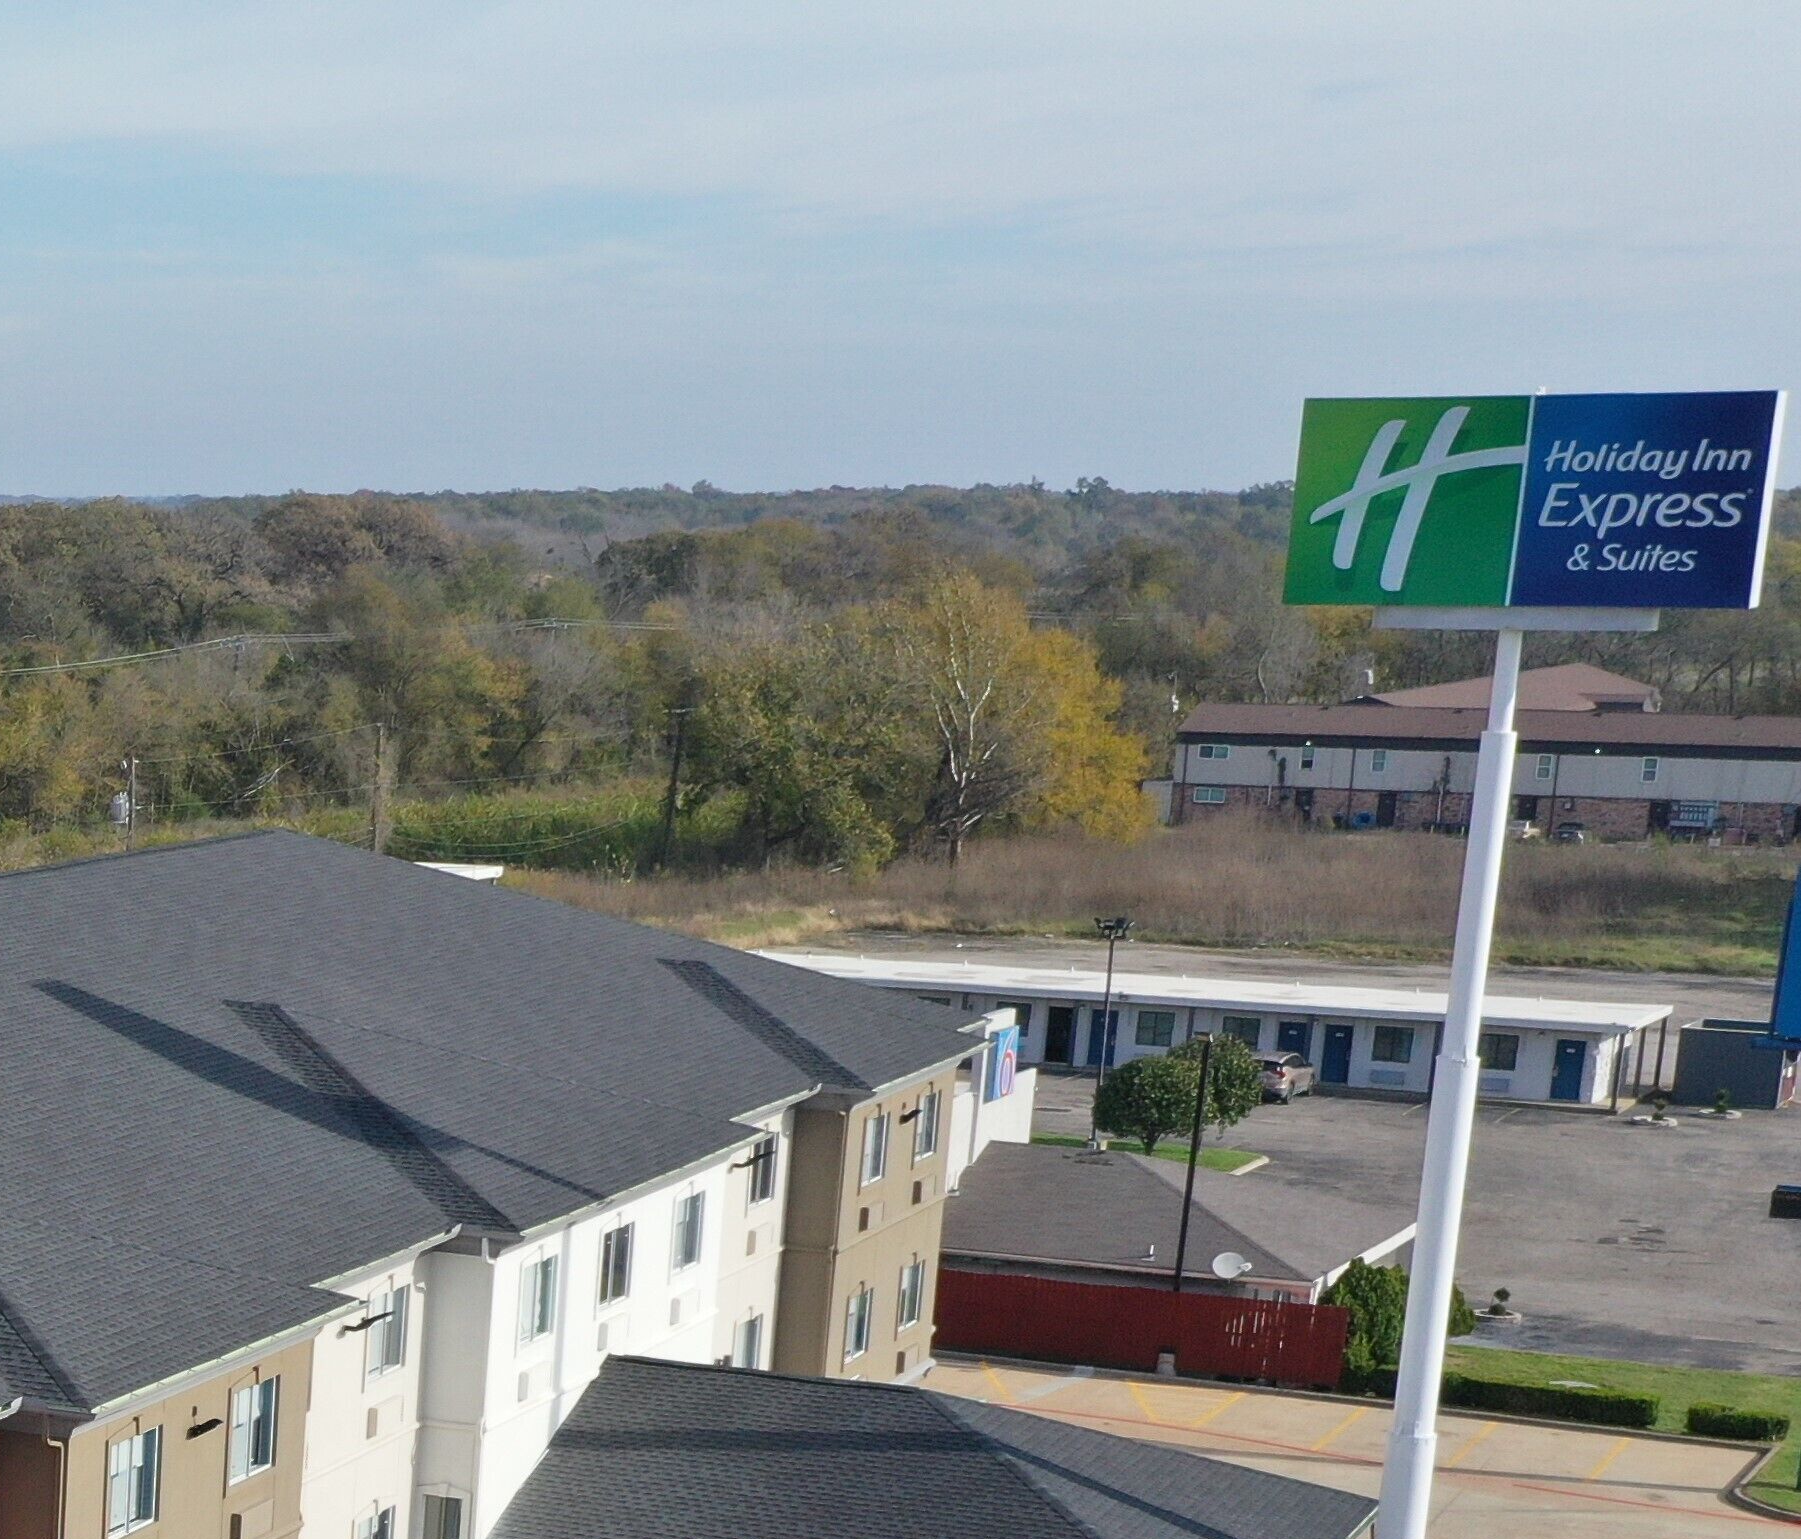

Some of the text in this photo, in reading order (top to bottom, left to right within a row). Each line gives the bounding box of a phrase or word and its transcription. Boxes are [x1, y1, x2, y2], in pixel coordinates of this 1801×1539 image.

[1543, 438, 1752, 480] Holiday Inn
[1538, 482, 1747, 540] Express
[1566, 543, 1698, 572] & Suites
